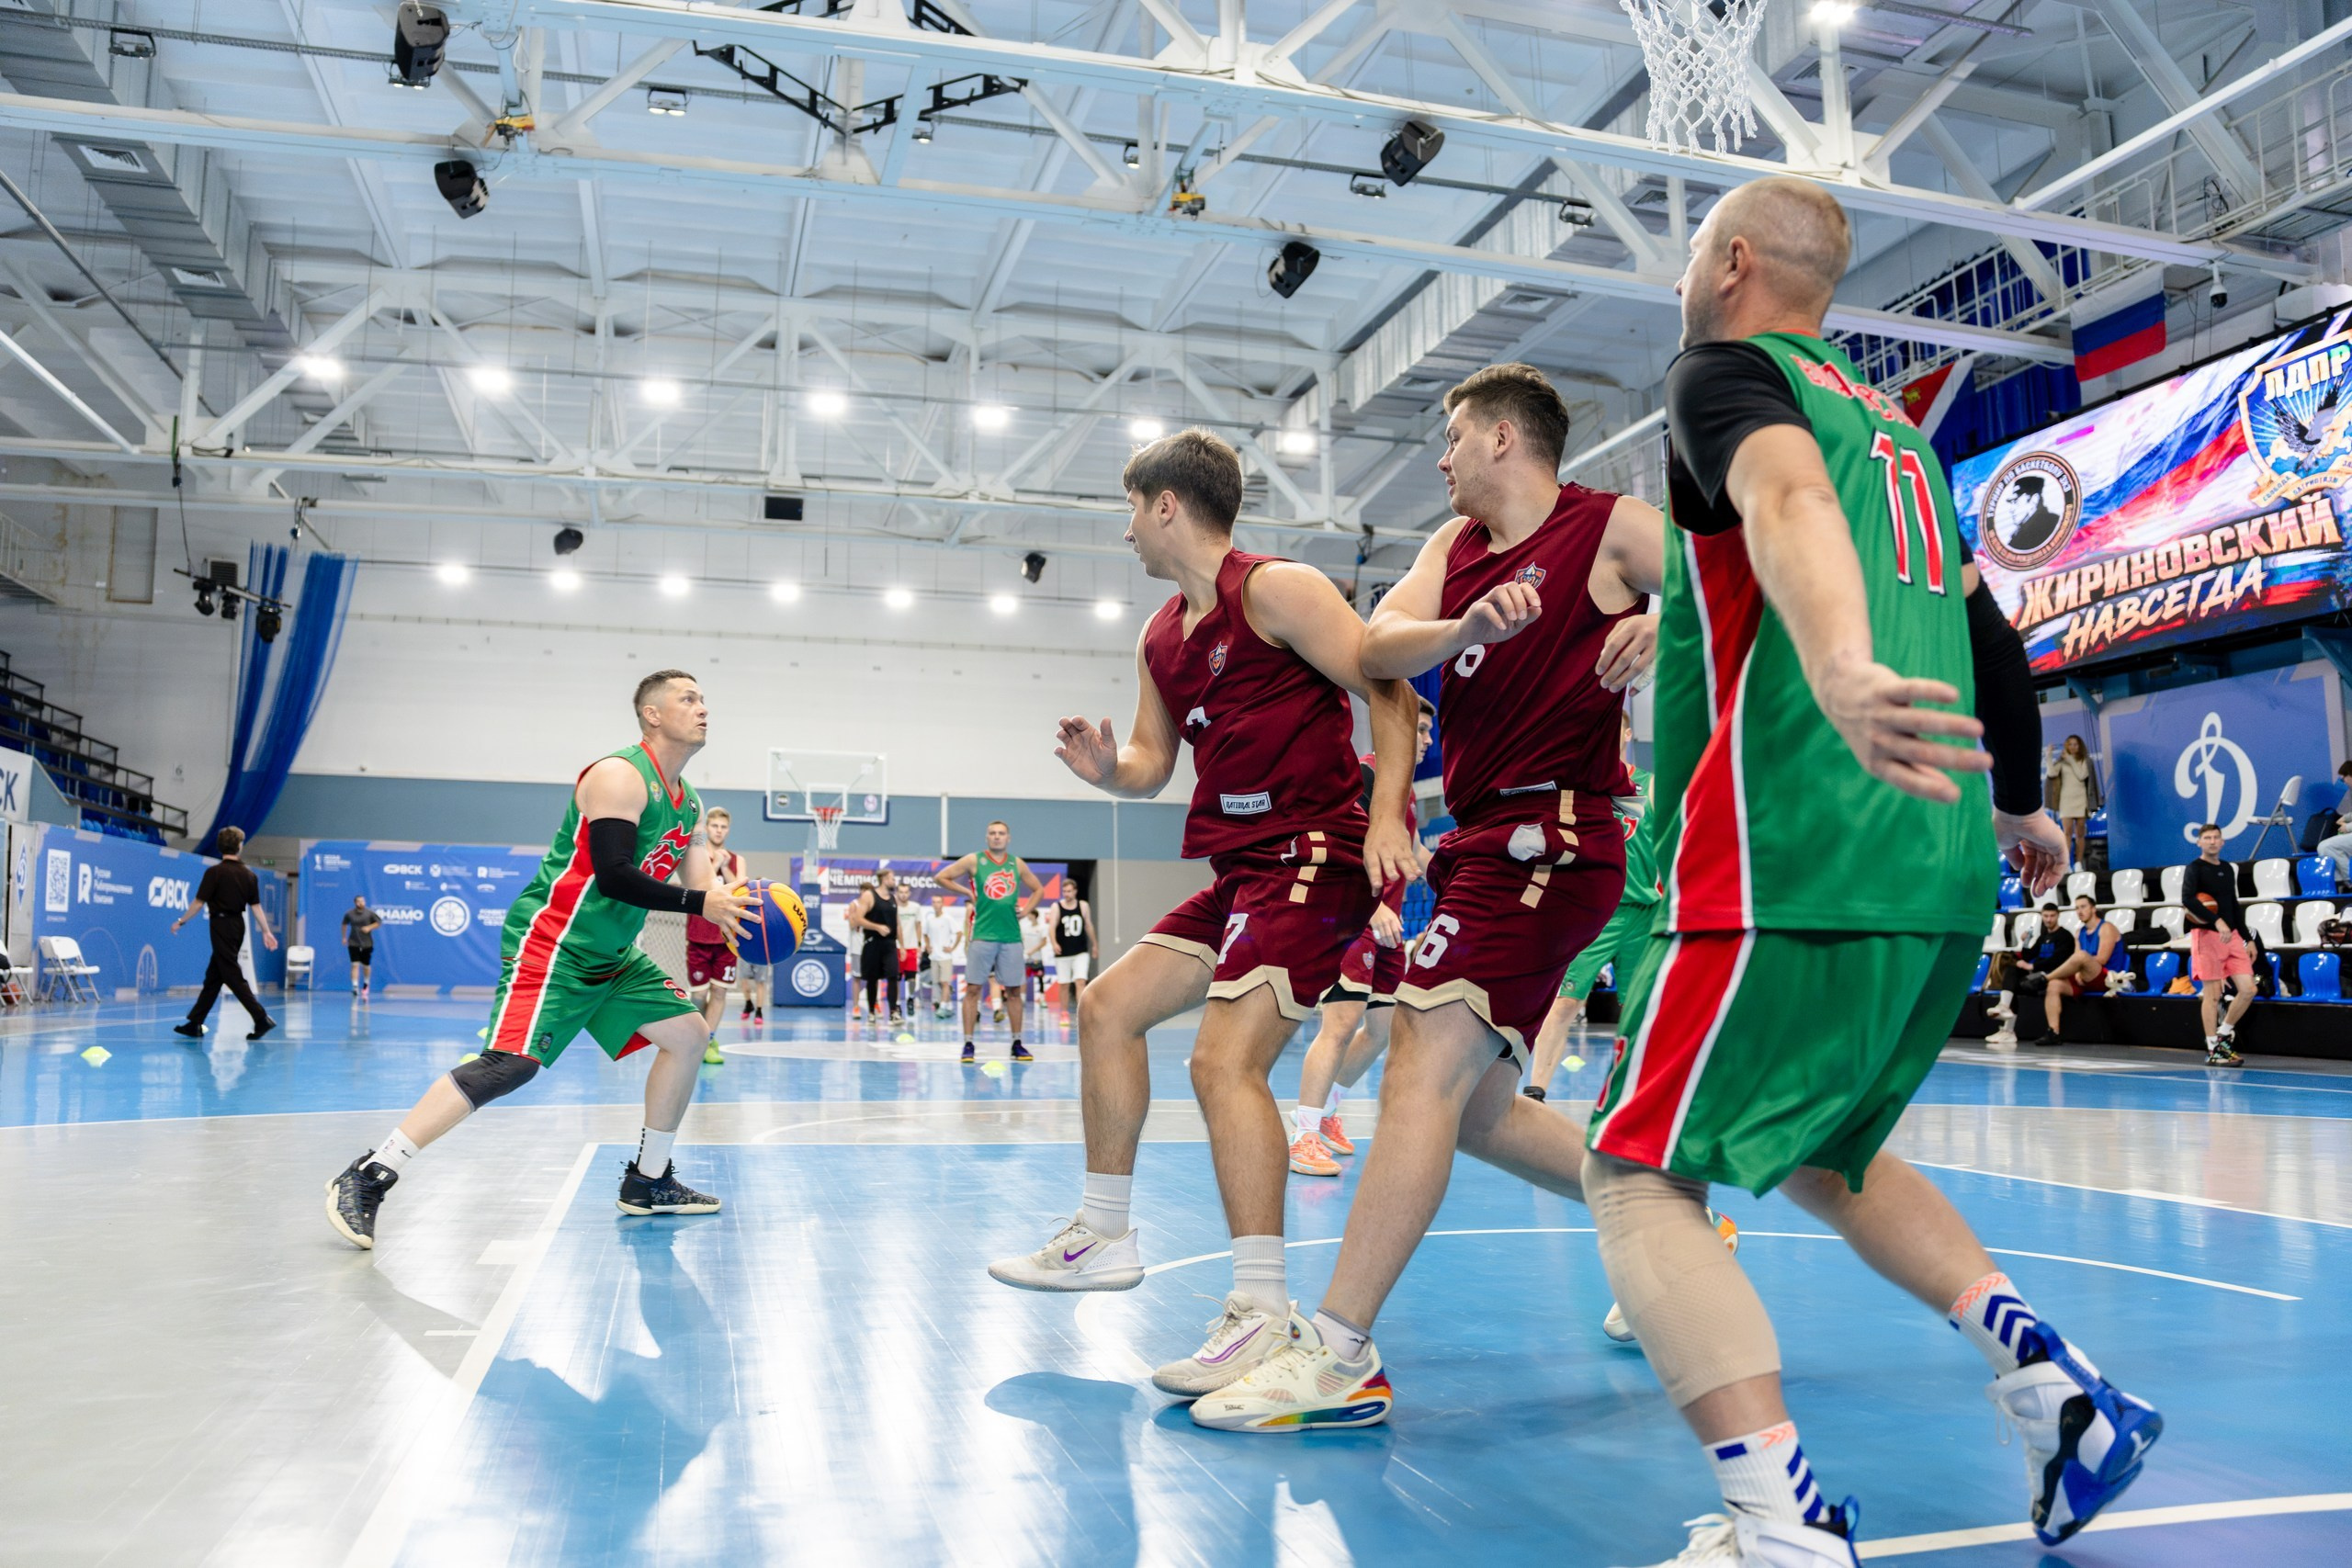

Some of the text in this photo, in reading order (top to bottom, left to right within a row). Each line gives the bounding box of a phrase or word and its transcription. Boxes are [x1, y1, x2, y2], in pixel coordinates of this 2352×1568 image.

[2264, 344, 2351, 401] ЛДПР
[2262, 476, 2292, 502] СВОБОДА
[2017, 491, 2343, 631] ЖИРИНОВСКИЙ
[2062, 555, 2268, 661] НАВСЕГДА
[1251, 798, 1266, 809] STAR
[1217, 912, 1250, 964] 7
[1415, 913, 1460, 969] 6
